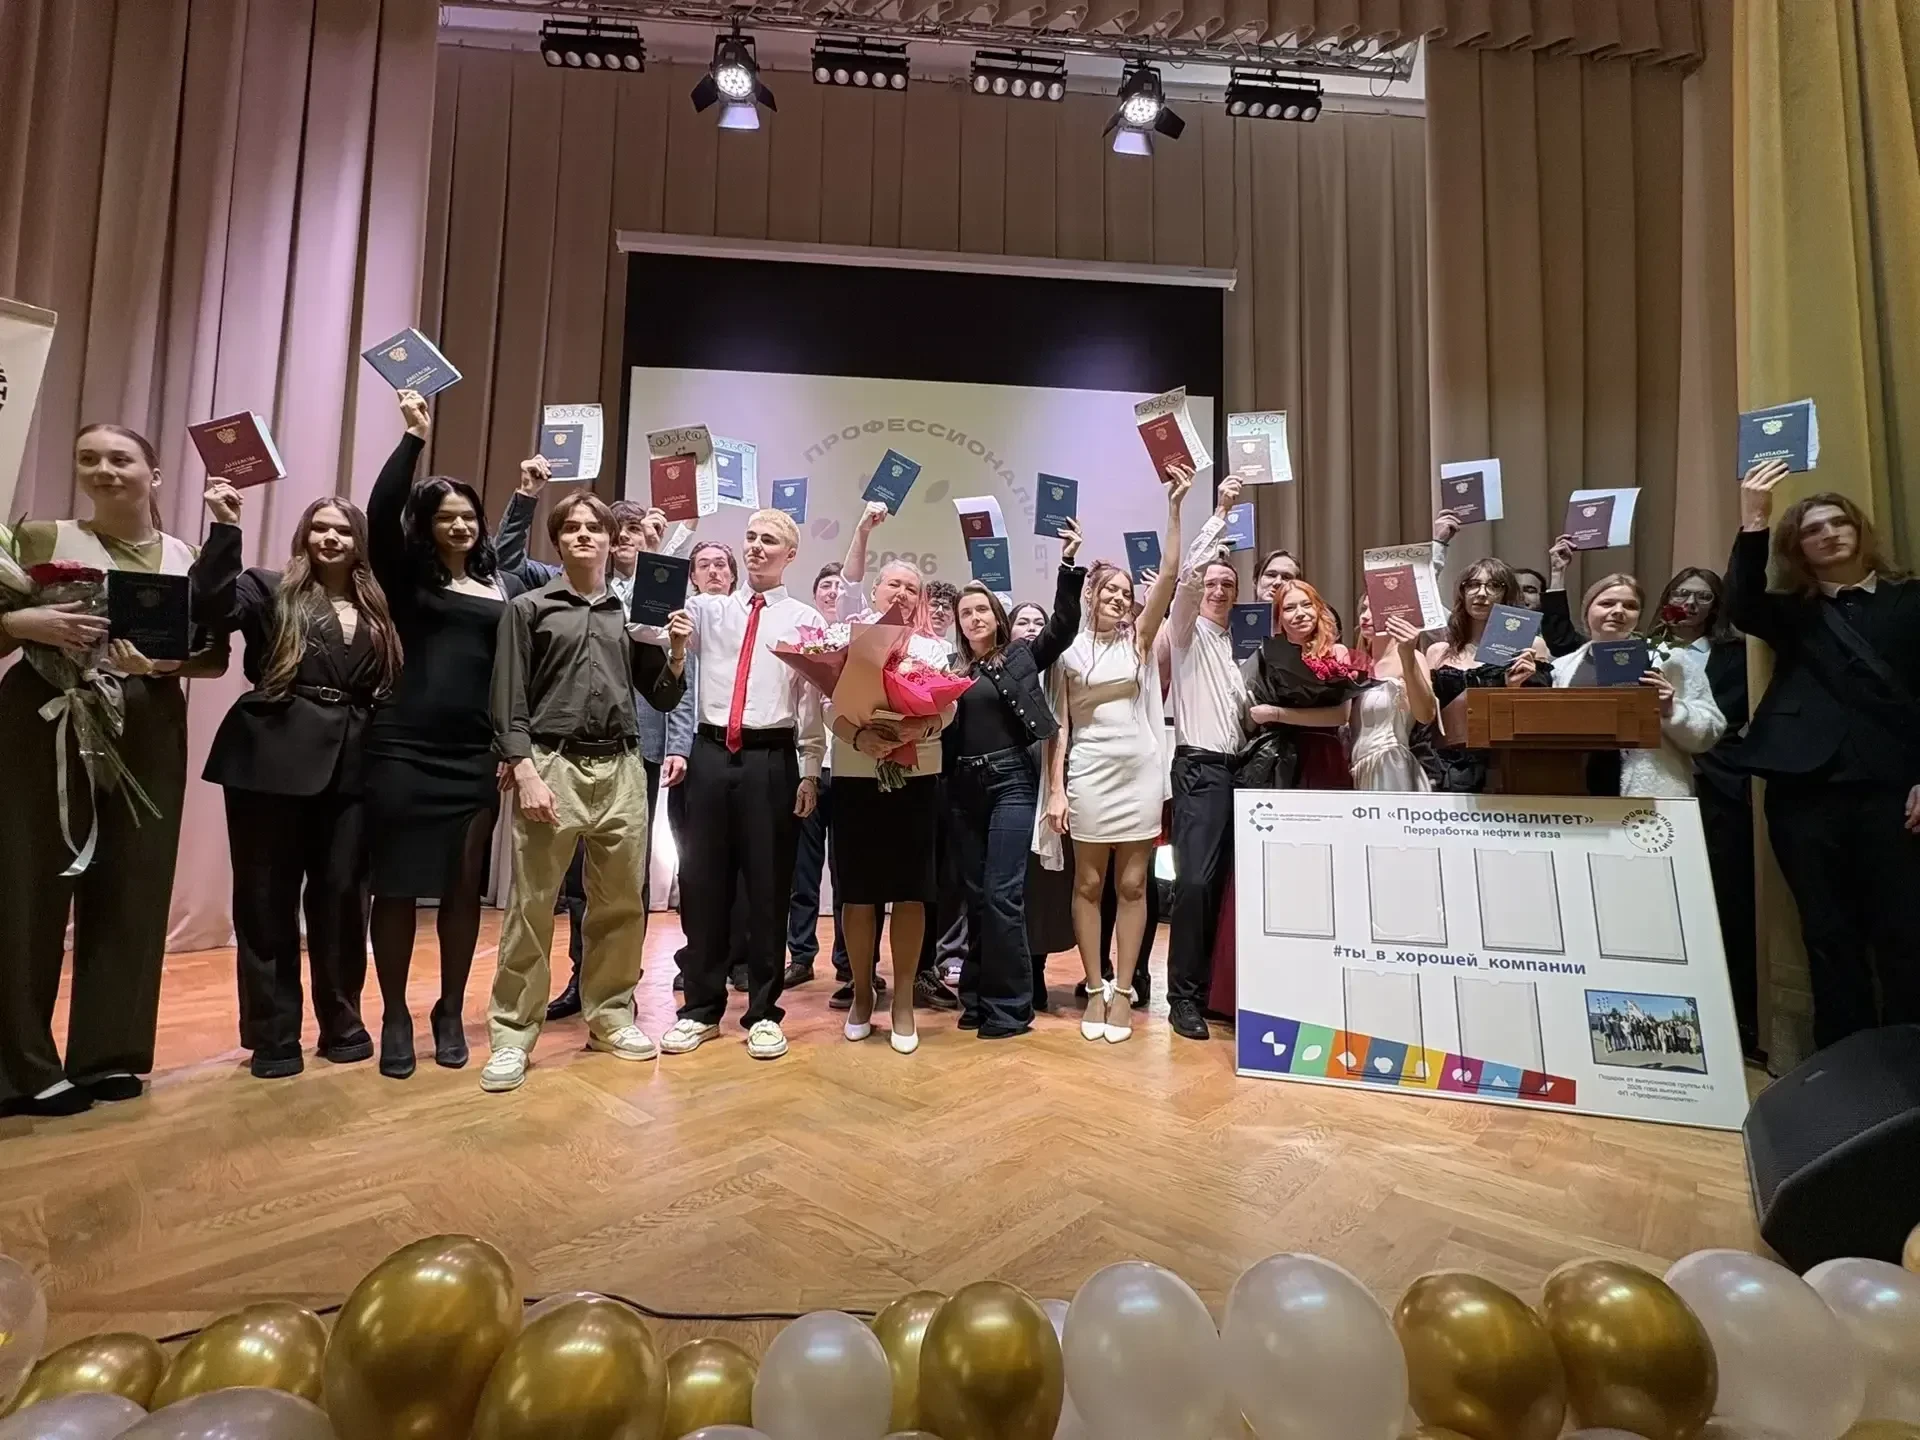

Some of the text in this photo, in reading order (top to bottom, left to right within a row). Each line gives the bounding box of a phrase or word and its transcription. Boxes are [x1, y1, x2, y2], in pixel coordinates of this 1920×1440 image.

[1753, 449, 1789, 459] ДИПЛОМ
[802, 418, 1049, 580] ПРОФЕССИОНАЛИЕТ
[1352, 806, 1381, 820] ФП
[1387, 807, 1594, 825] «Профессионалитет»
[1403, 825, 1561, 839] Переработка нефти и газа
[1621, 809, 1675, 853] ПРОФЕССИОНАЛИТЕТ
[1333, 945, 1587, 975] #ты_в_хорошей_компании
